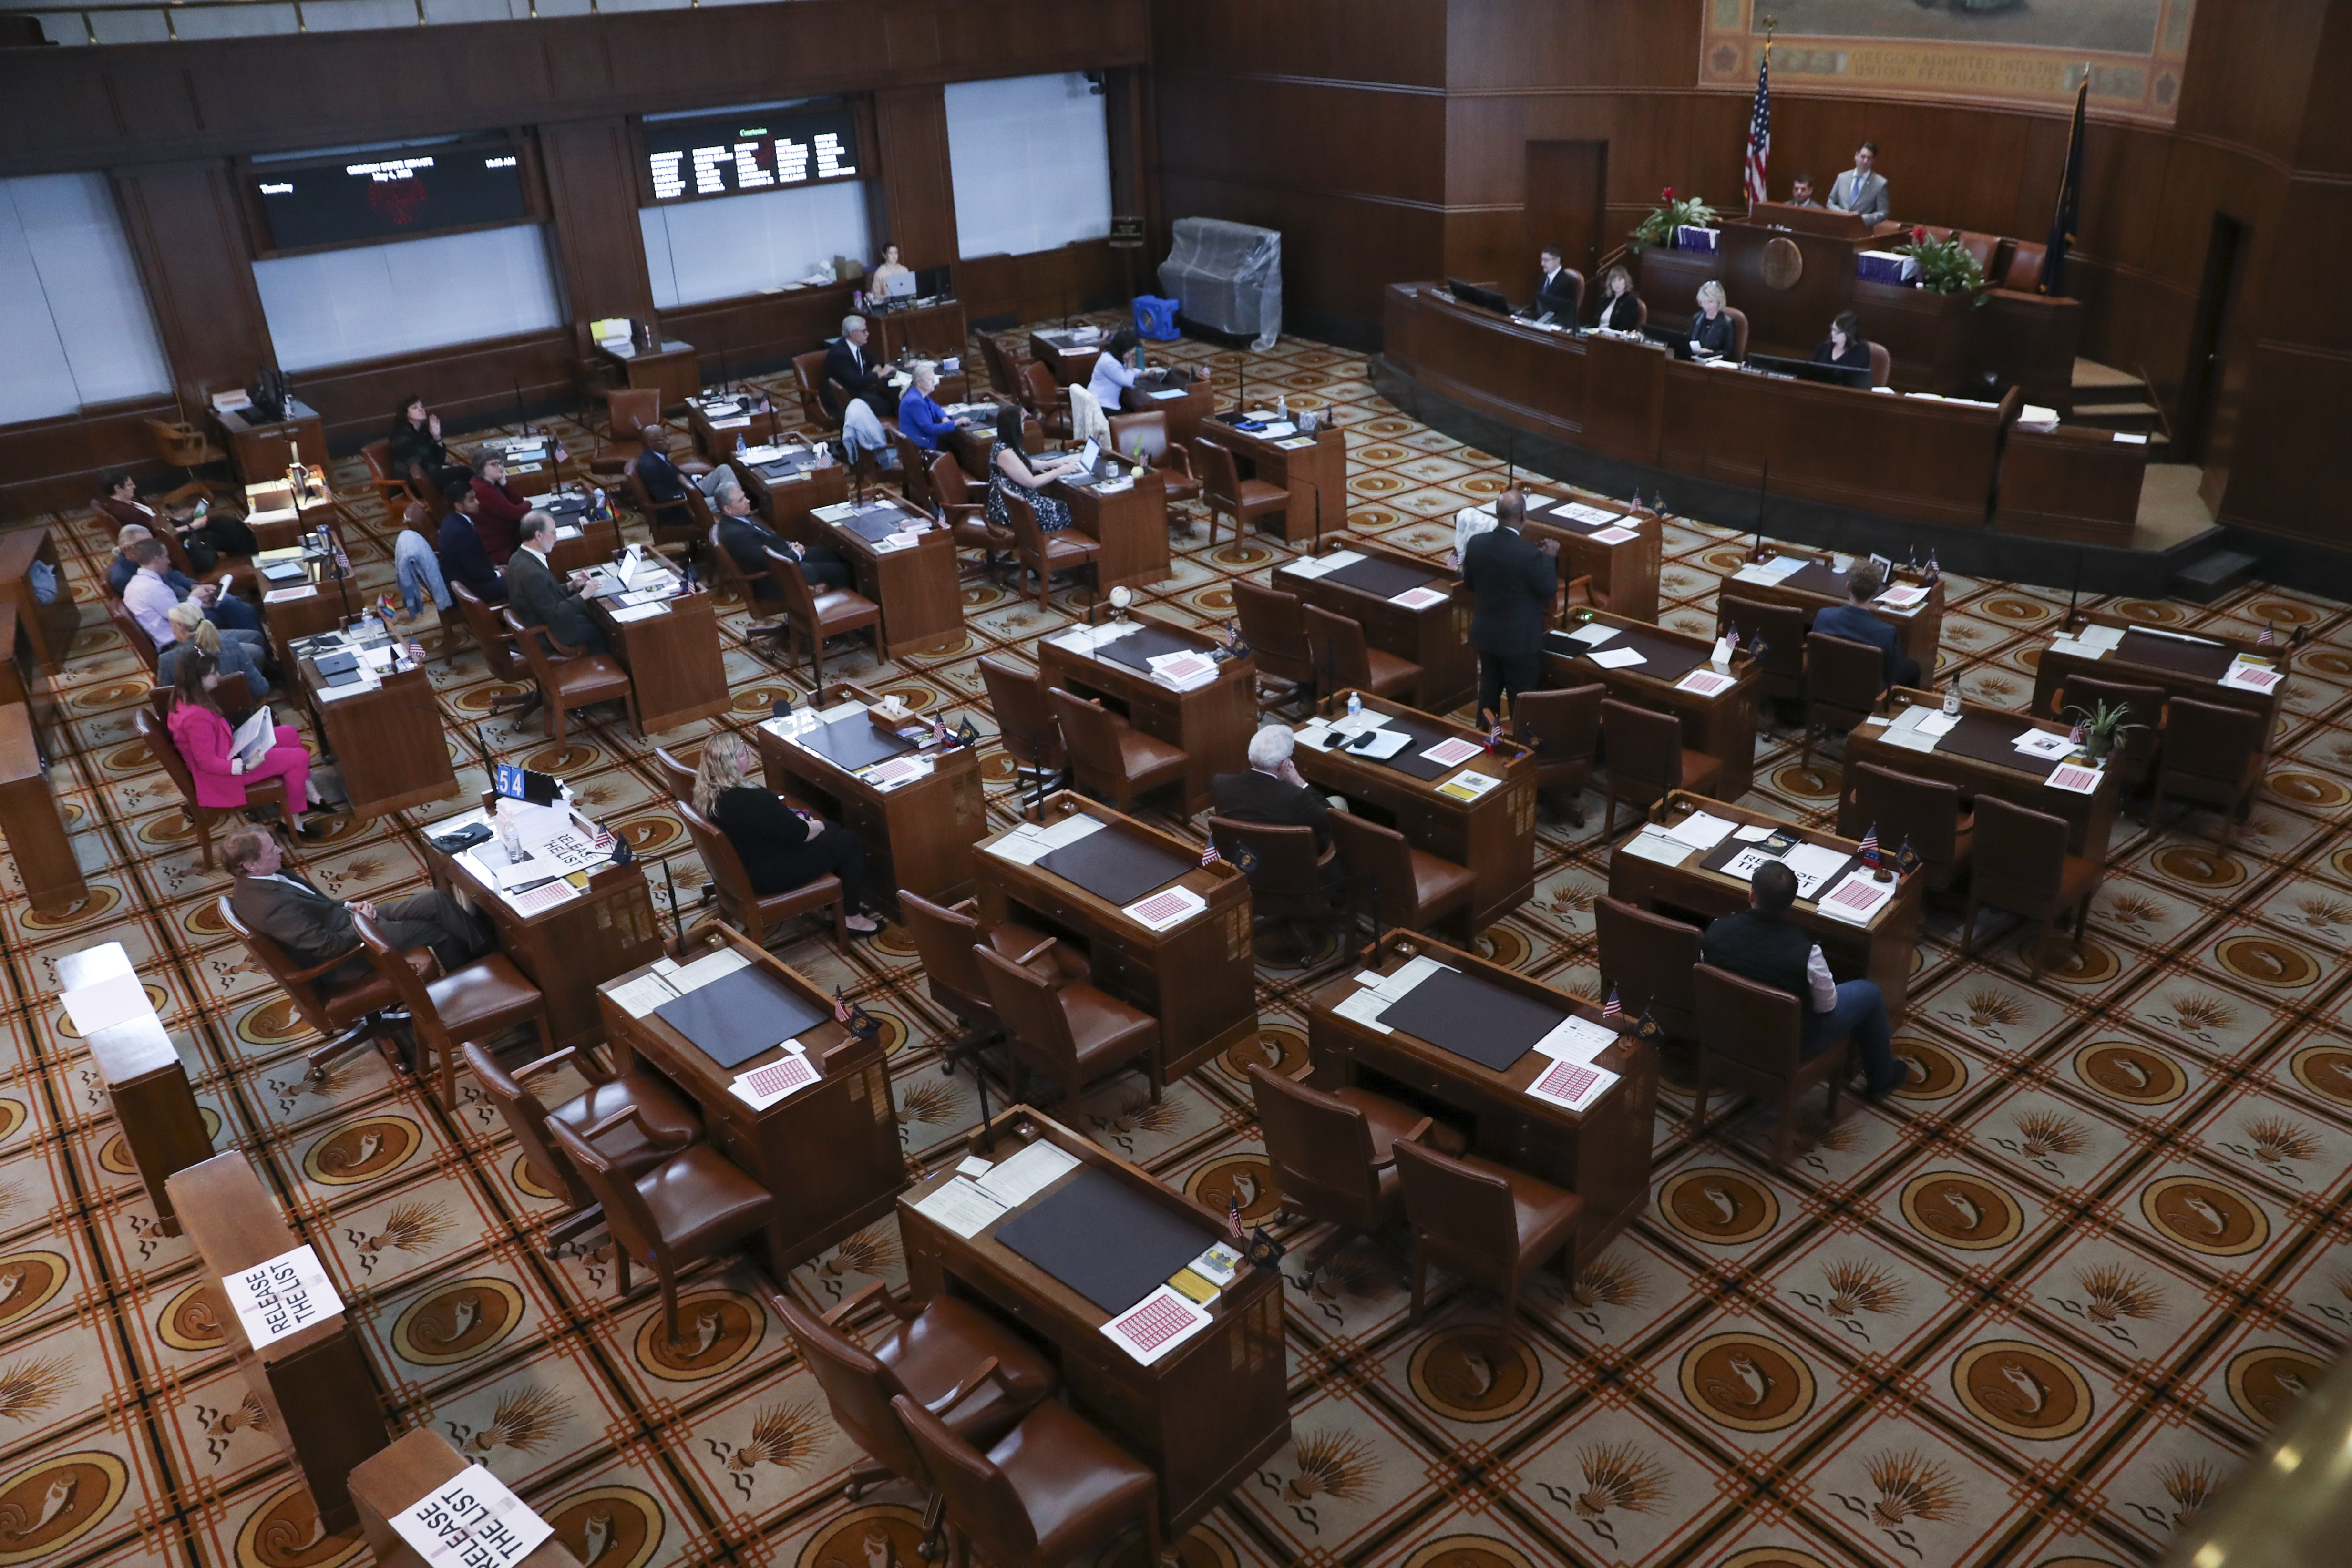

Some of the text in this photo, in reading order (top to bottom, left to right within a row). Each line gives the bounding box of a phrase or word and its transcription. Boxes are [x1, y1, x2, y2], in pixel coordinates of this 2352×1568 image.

[499, 770, 522, 796] 54
[544, 840, 584, 867] HE LIST
[246, 1270, 291, 1334] RELEASE
[270, 1261, 316, 1323] THE LIST
[1145, 1307, 1162, 1320] FOLLOW
[1166, 1323, 1178, 1332] LAW
[1149, 1304, 1167, 1317] FOLLOW
[1171, 1321, 1182, 1329] LAW
[1154, 1301, 1171, 1314] FOLLOW
[1175, 1318, 1187, 1326] LAW
[1159, 1298, 1176, 1311] FOLLOW
[1180, 1315, 1191, 1323] LAW
[1162, 1295, 1180, 1309] FOLLOW
[1184, 1312, 1195, 1321] LAW
[1122, 1322, 1139, 1335] FOLLOW
[1143, 1339, 1155, 1347] LAW
[1126, 1319, 1144, 1332] FOLLOW
[1148, 1336, 1160, 1344] LAW
[1131, 1315, 1149, 1329] FOLLOW
[1152, 1332, 1164, 1341] LAW
[1136, 1312, 1153, 1326] FOLLOW
[1157, 1330, 1169, 1338] LAW
[1140, 1310, 1158, 1323] FOLLOW
[1162, 1327, 1173, 1335] LAW
[1118, 1324, 1135, 1338] FOLLOW
[1139, 1342, 1150, 1350] LAW
[441, 1487, 523, 1560] THE LIST
